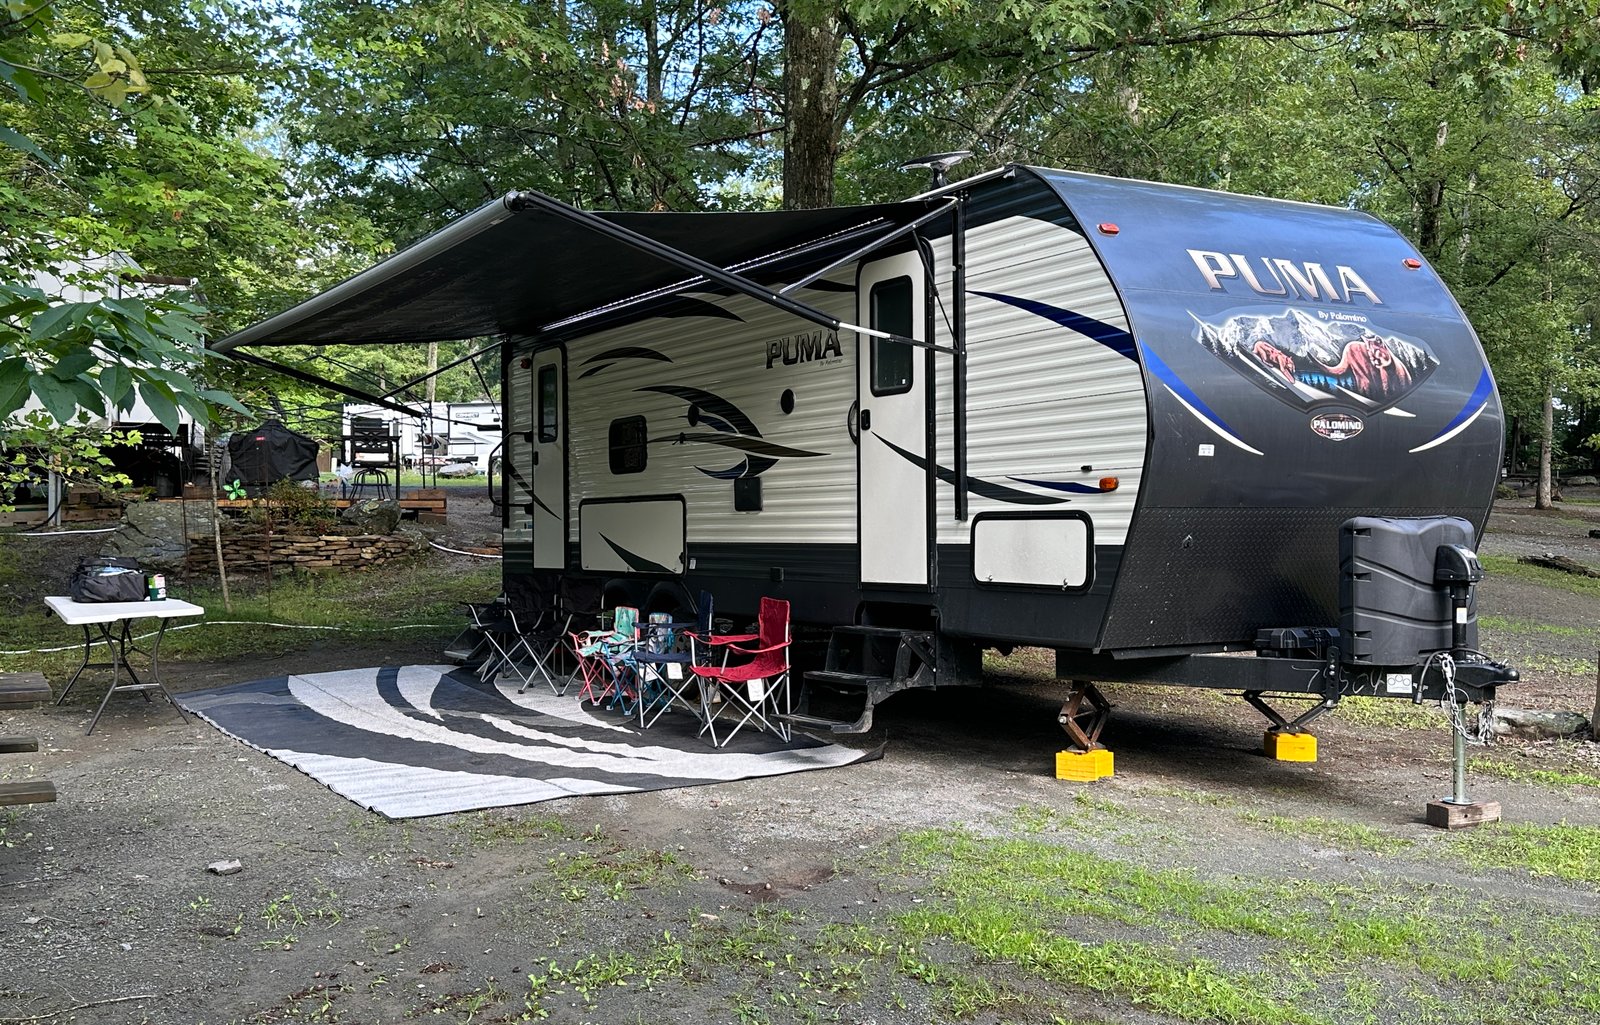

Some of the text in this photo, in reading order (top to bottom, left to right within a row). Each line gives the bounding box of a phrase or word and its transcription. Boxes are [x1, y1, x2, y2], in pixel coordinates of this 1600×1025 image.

[1186, 249, 1384, 305] PUMA
[1317, 310, 1367, 323] By Palomino
[766, 328, 843, 369] PUMA
[1313, 419, 1361, 430] PALOMINO
